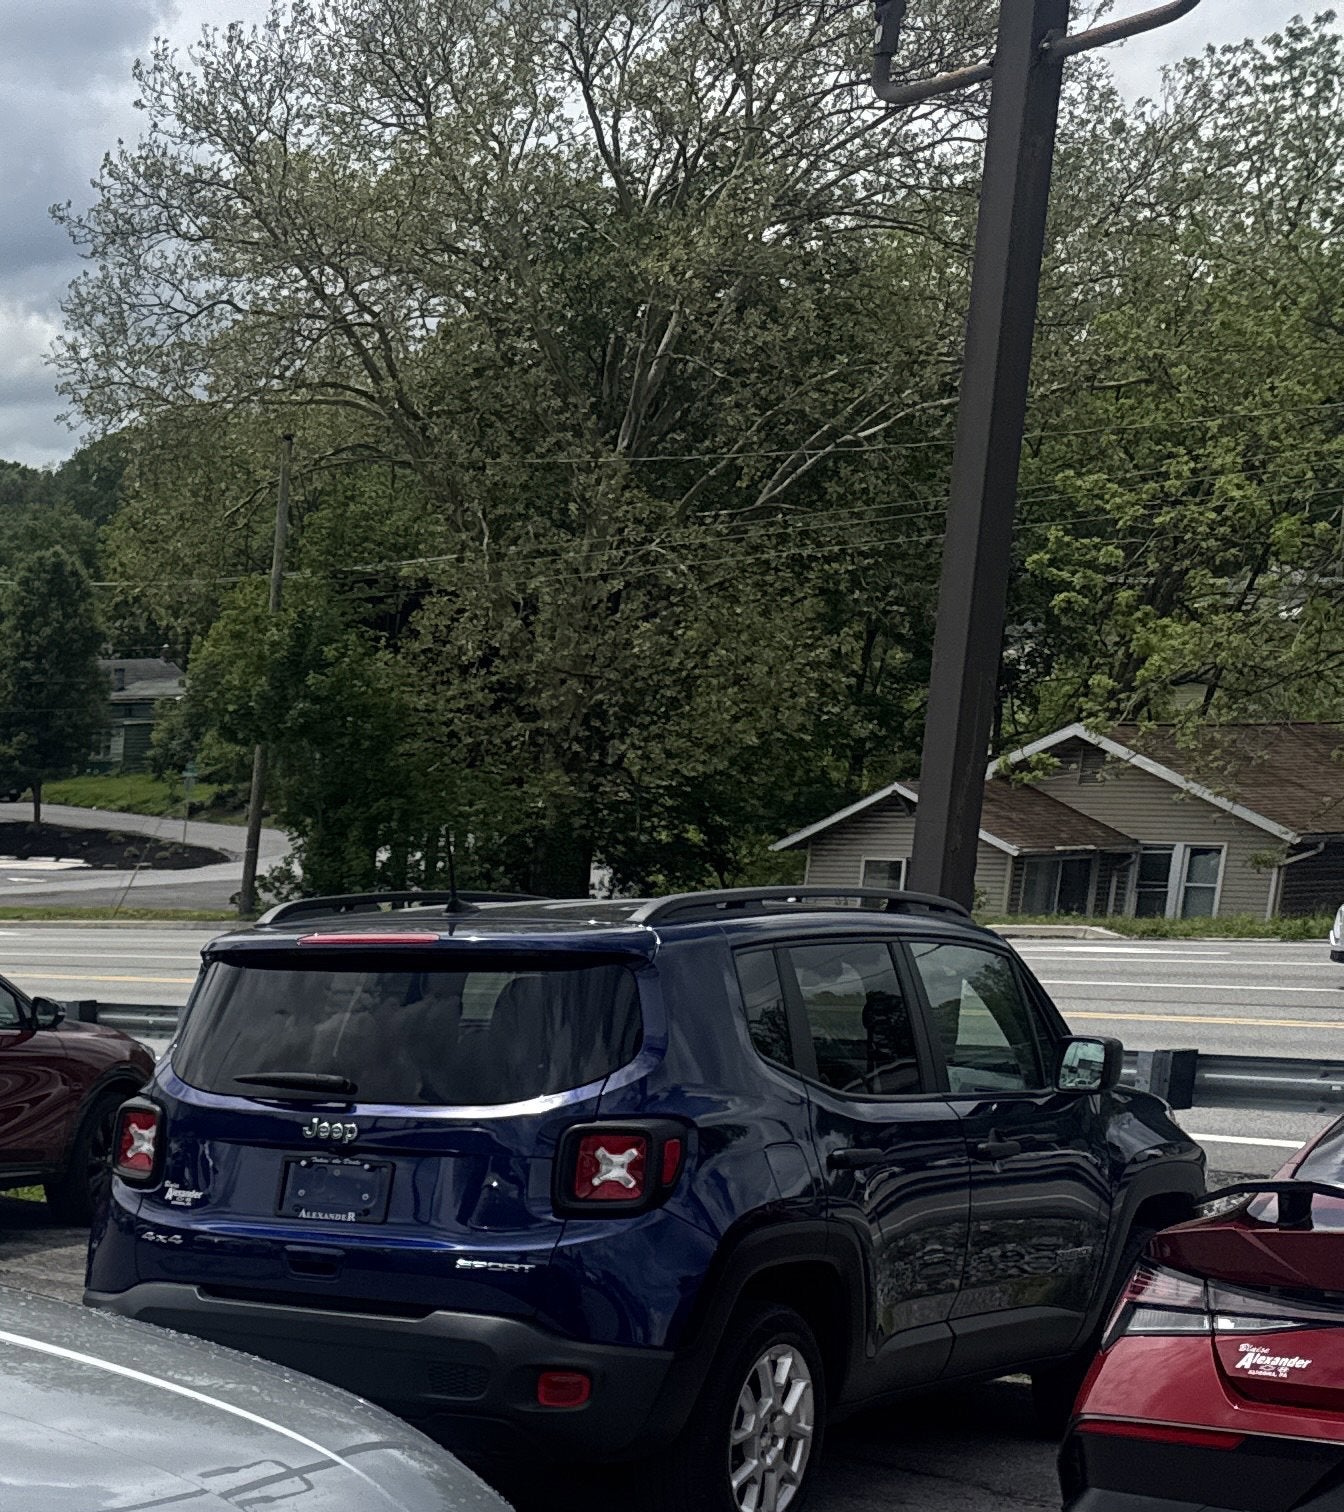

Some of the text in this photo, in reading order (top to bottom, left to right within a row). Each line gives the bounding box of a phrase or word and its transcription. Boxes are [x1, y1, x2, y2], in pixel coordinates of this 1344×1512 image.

[302, 1117, 358, 1143] Jeep
[455, 1258, 536, 1273] SPORT
[1235, 1352, 1312, 1369] Alexander
